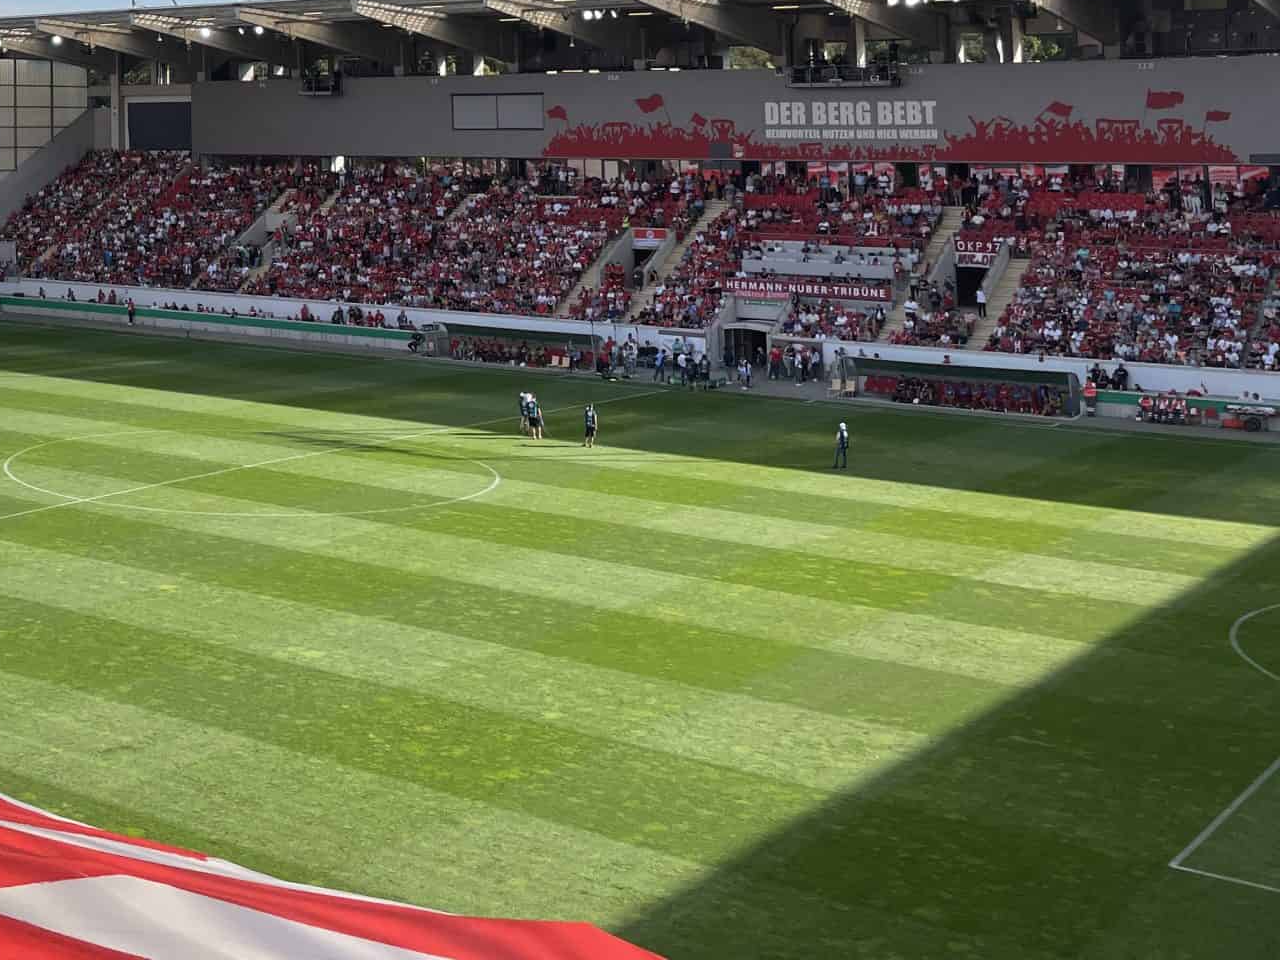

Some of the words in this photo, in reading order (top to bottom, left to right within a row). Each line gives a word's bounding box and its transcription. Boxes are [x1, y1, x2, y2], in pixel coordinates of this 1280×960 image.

[764, 101, 806, 126] DER
[812, 101, 872, 126] BERG
[876, 100, 937, 125] BEBT
[726, 279, 887, 298] HERMANN-NUBER-TRIBÜNE
